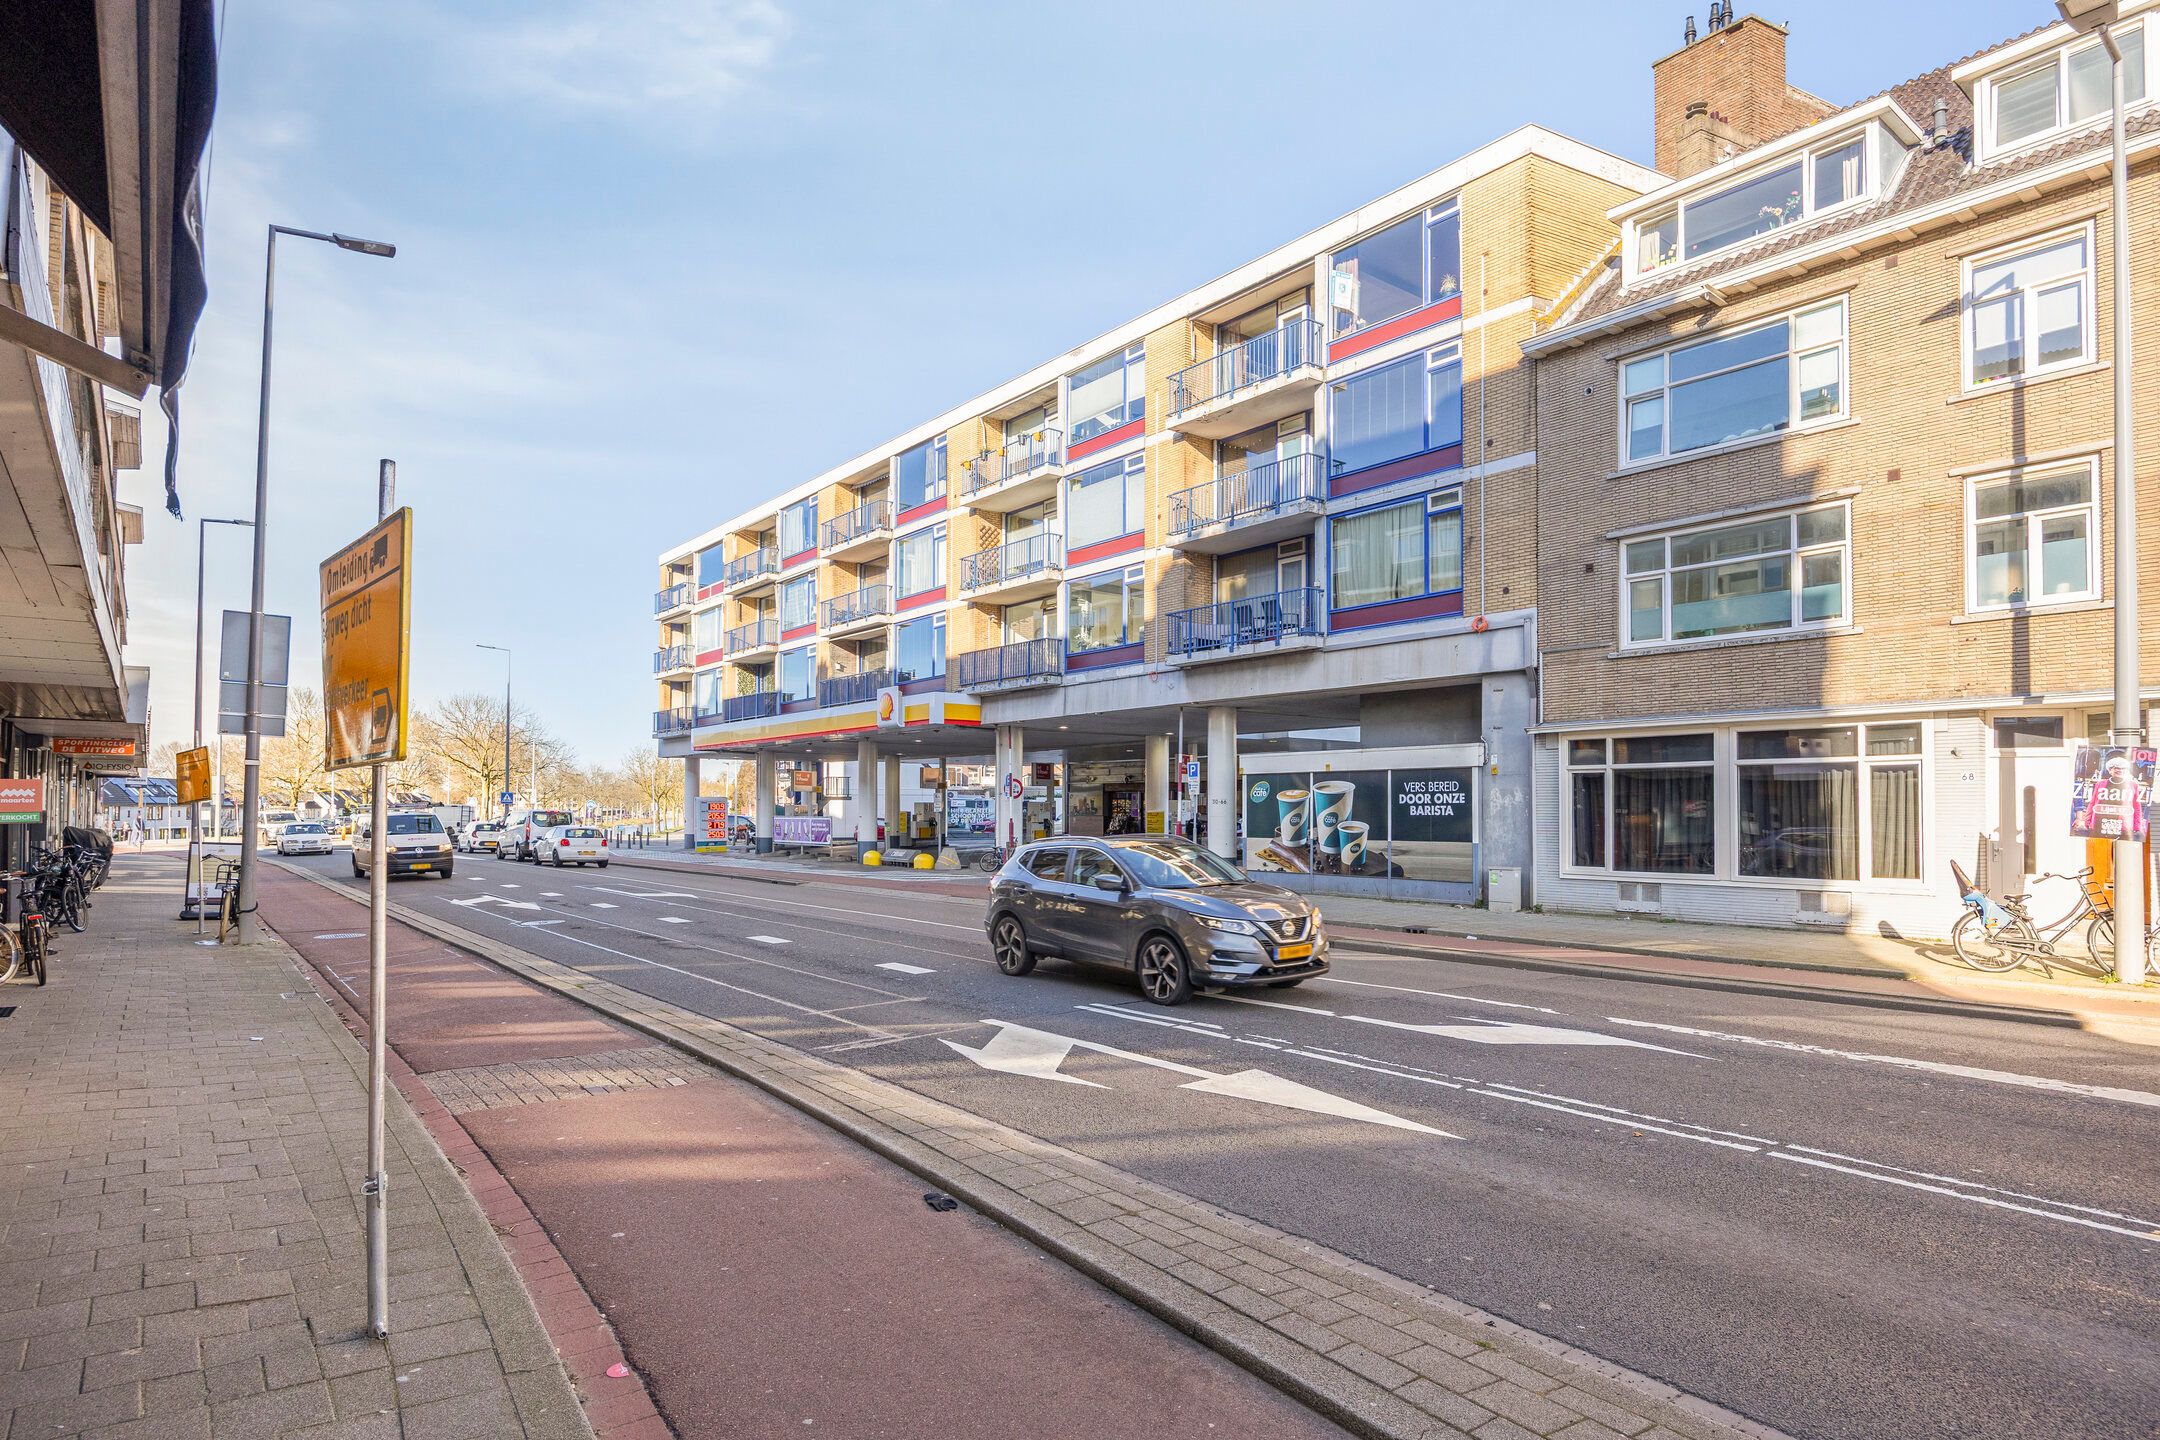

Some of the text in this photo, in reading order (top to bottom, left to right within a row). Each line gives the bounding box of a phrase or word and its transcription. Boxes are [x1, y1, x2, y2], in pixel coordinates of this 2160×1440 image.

[326, 552, 368, 595] Omleiding
[351, 593, 372, 629] dicht
[58, 739, 132, 747] SPORTINGCLUB
[82, 746, 126, 754] UITWEG
[1190, 765, 1196, 776] P
[1962, 773, 1974, 781] 68
[1252, 787, 1268, 797] café
[1404, 781, 1460, 792] VERS BEREID
[1399, 792, 1466, 804] DOOR ONZE
[2073, 782, 2095, 803] Zij
[2136, 785, 2155, 807] Zij
[1409, 805, 1454, 816] BARISTA
